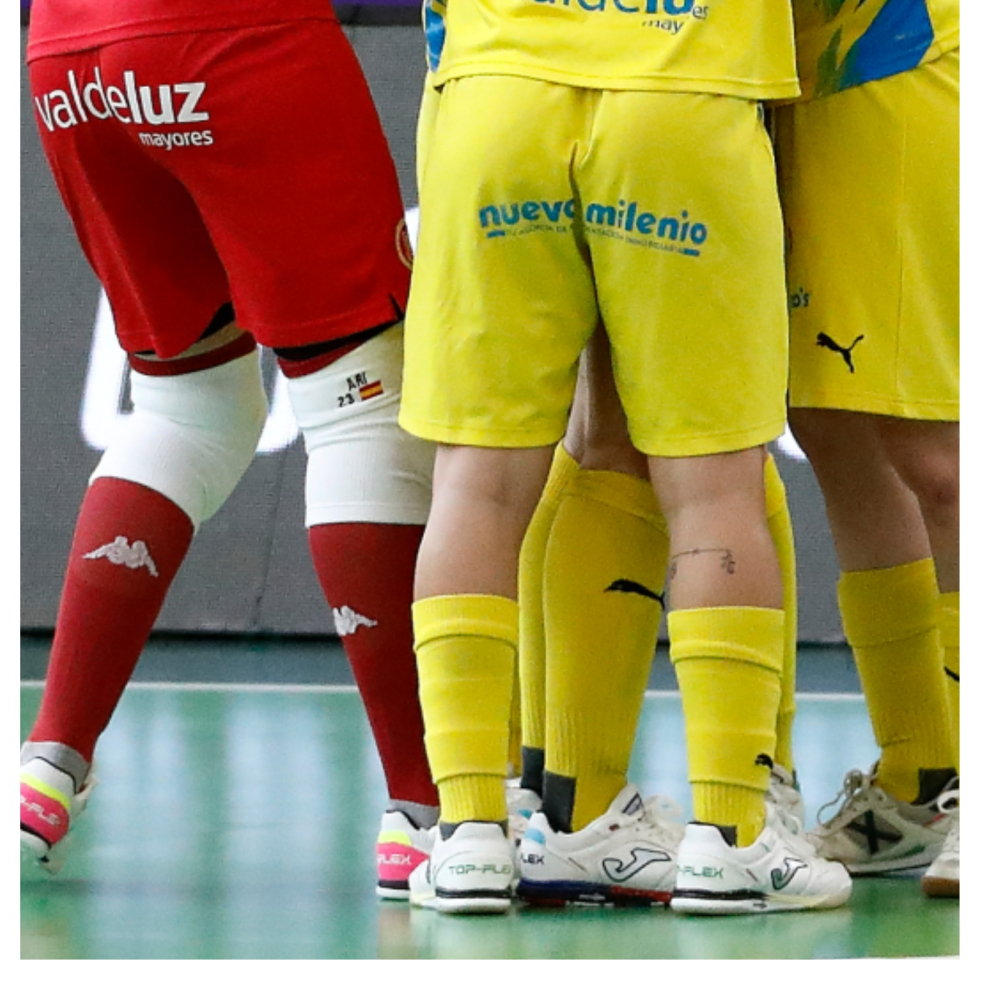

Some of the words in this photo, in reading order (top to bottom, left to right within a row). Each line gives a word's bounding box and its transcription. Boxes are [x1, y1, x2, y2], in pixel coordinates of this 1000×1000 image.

[35, 66, 210, 132] valdeluz
[138, 130, 214, 150] mayores
[586, 199, 707, 245] milenio
[346, 371, 368, 391] ARI
[337, 393, 355, 408] 23
